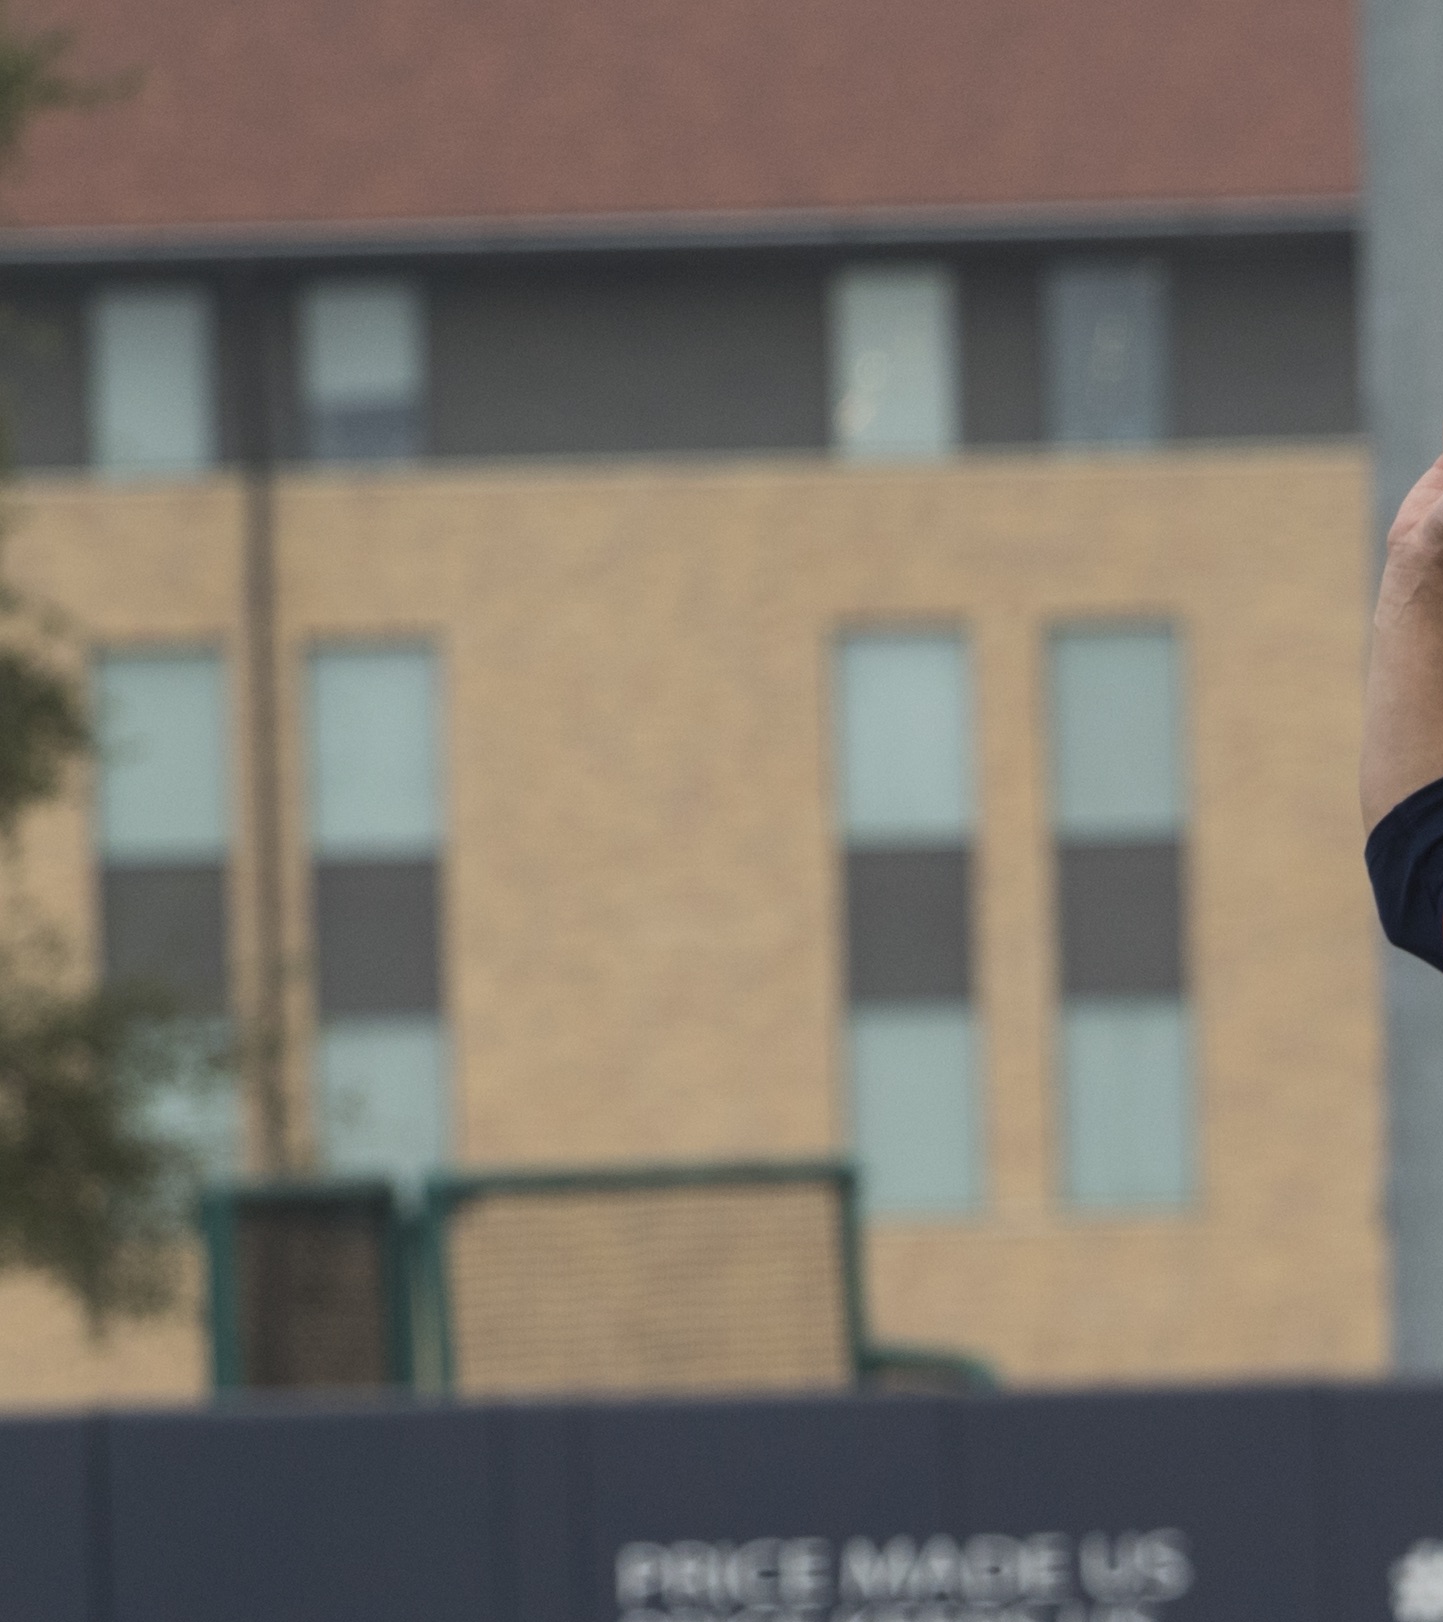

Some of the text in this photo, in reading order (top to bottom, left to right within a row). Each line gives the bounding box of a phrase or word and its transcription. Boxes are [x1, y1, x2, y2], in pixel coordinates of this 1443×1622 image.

[614, 1527, 1196, 1611] PRICE MADE US
